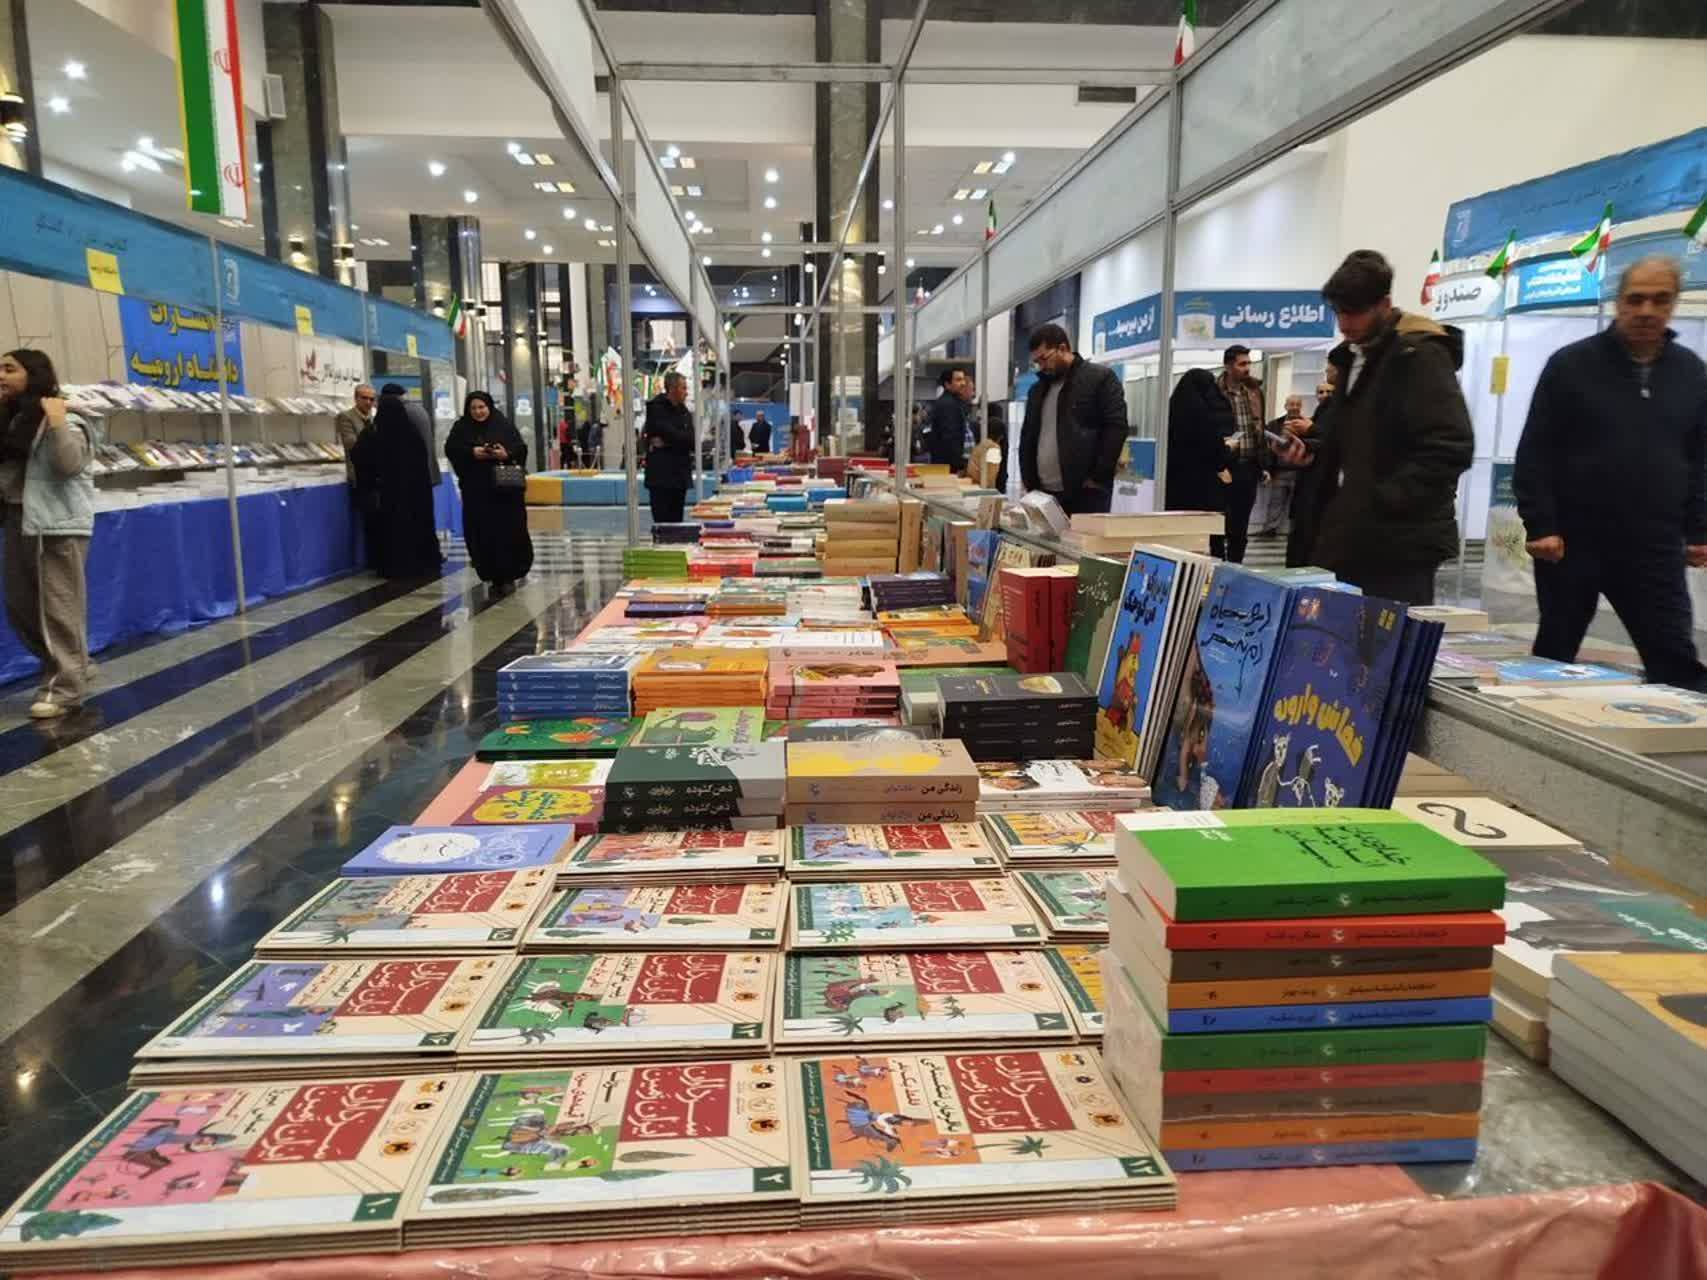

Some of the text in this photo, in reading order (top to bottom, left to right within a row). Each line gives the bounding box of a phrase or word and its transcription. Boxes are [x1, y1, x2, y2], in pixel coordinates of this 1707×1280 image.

[1221, 304, 1325, 328] اطلاع رسانی
[131, 351, 184, 387] ارومیه
[1275, 683, 1364, 767] خفاش وارونه
[685, 783, 713, 797] گشوده
[711, 783, 734, 796] ذهن
[920, 784, 936, 795] من
[937, 783, 963, 795] زندگی
[918, 808, 960, 821] زندگی من
[736, 1023, 758, 1037] ۱۳
[952, 1056, 1026, 1131] ایران زمین
[624, 1067, 681, 1138] ایران زمین
[257, 1086, 330, 1161] ایران زمین
[759, 1172, 783, 1184] ۲
[362, 1197, 392, 1214] ۱۰
